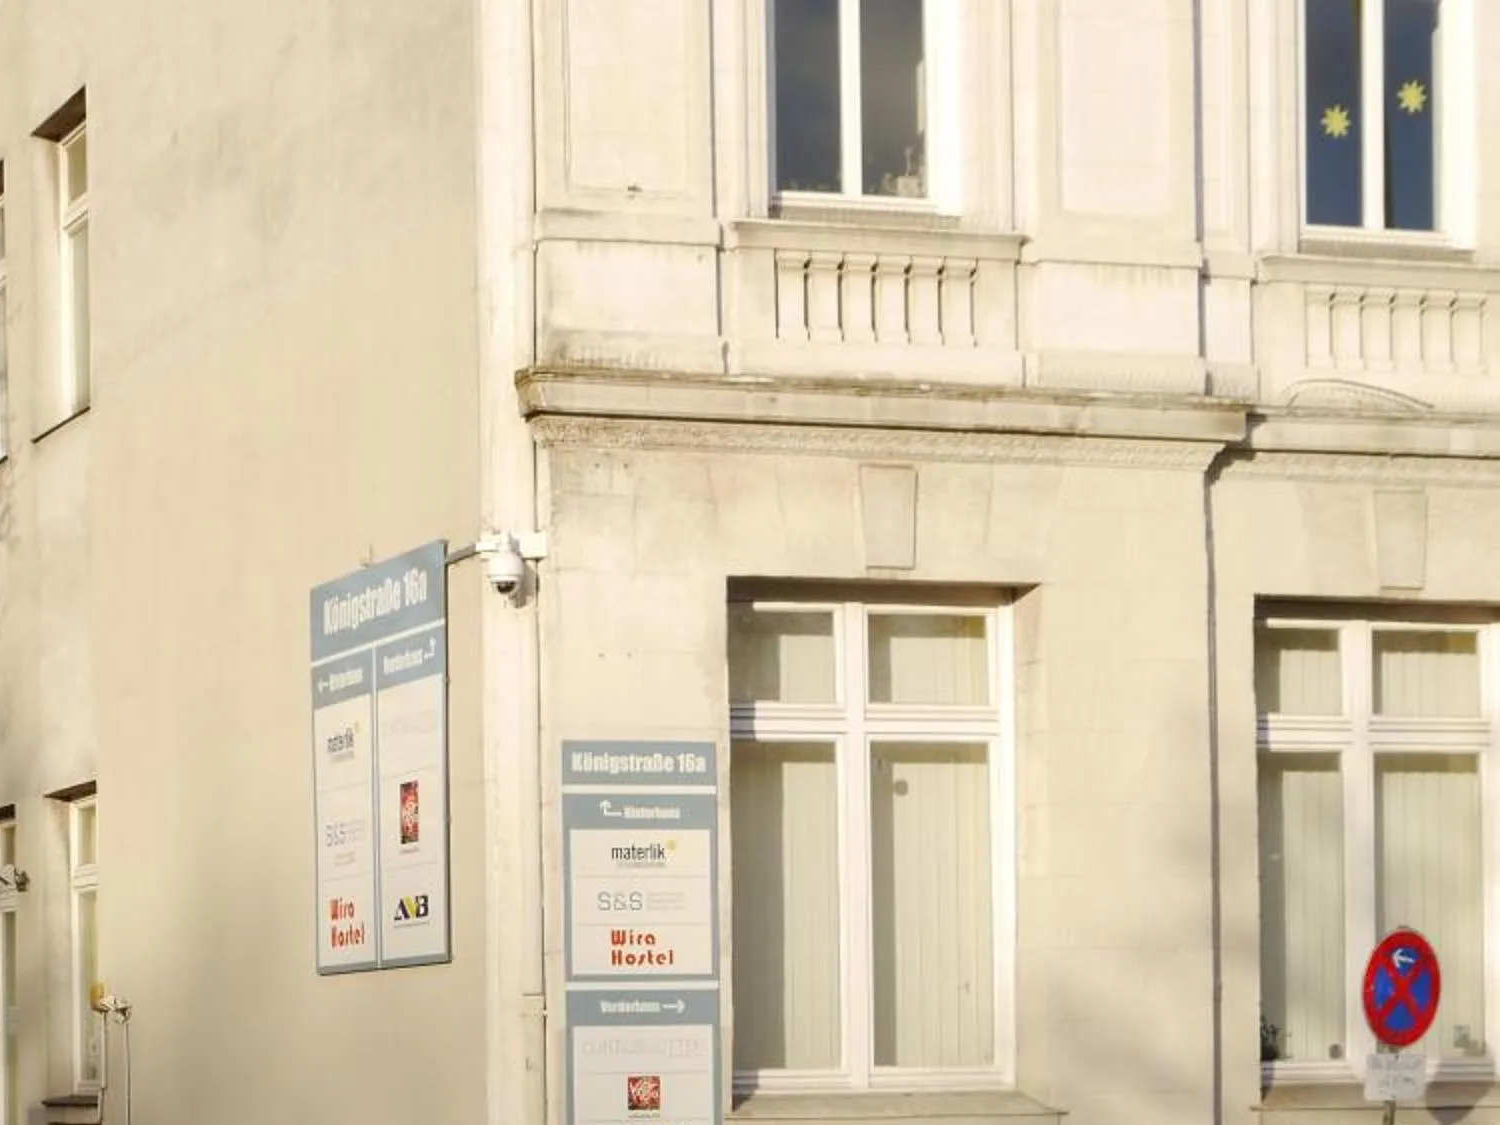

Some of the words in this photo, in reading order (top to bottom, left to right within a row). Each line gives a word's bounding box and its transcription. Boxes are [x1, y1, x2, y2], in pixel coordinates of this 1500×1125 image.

[323, 577, 401, 636] Königstraße
[571, 752, 675, 775] Königstraße
[676, 753, 707, 774] 16a
[597, 890, 643, 911] S&S
[611, 949, 675, 966] Hostel
